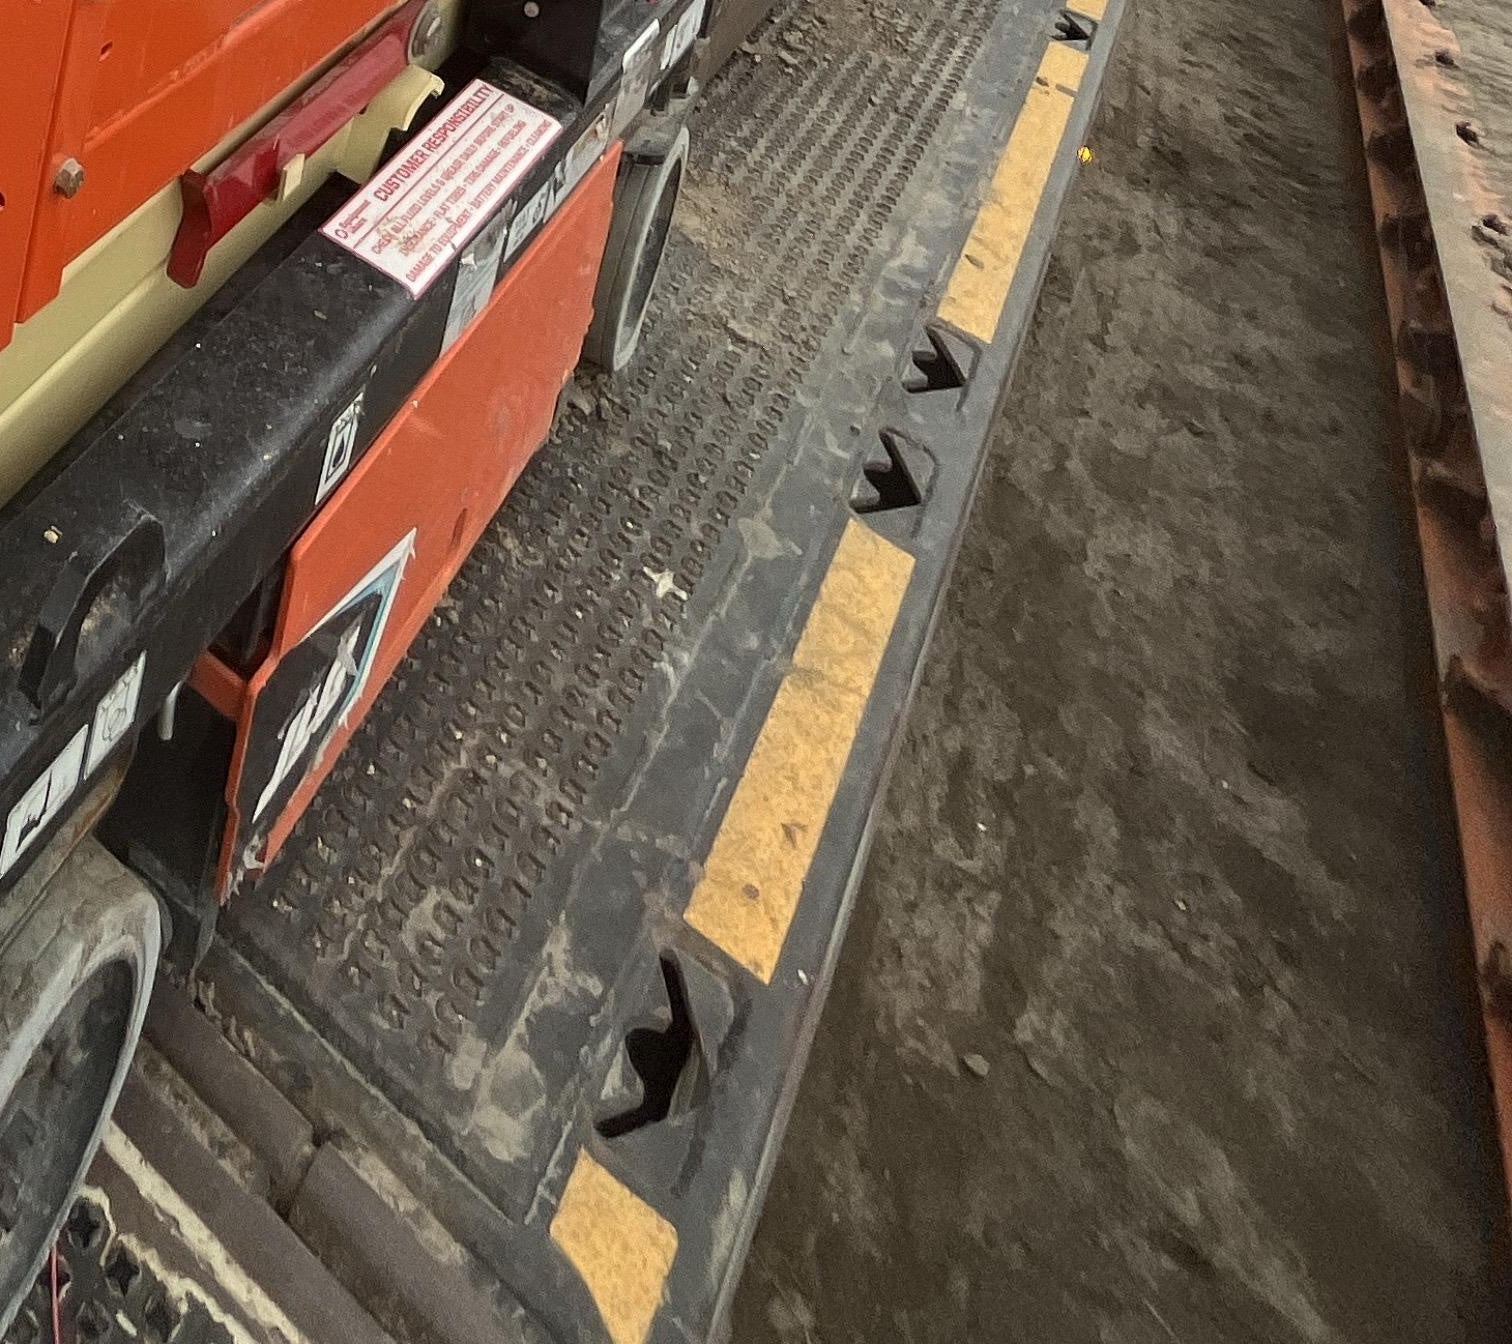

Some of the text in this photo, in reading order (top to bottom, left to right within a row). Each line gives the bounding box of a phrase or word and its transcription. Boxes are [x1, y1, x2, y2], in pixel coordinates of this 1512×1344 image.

[373, 84, 494, 201] CUSTOMER RESPONSIBILITY
[406, 252, 434, 281] DAMAGE
[438, 209, 472, 245] EQUIPMENT
[470, 182, 495, 208] BATTERY
